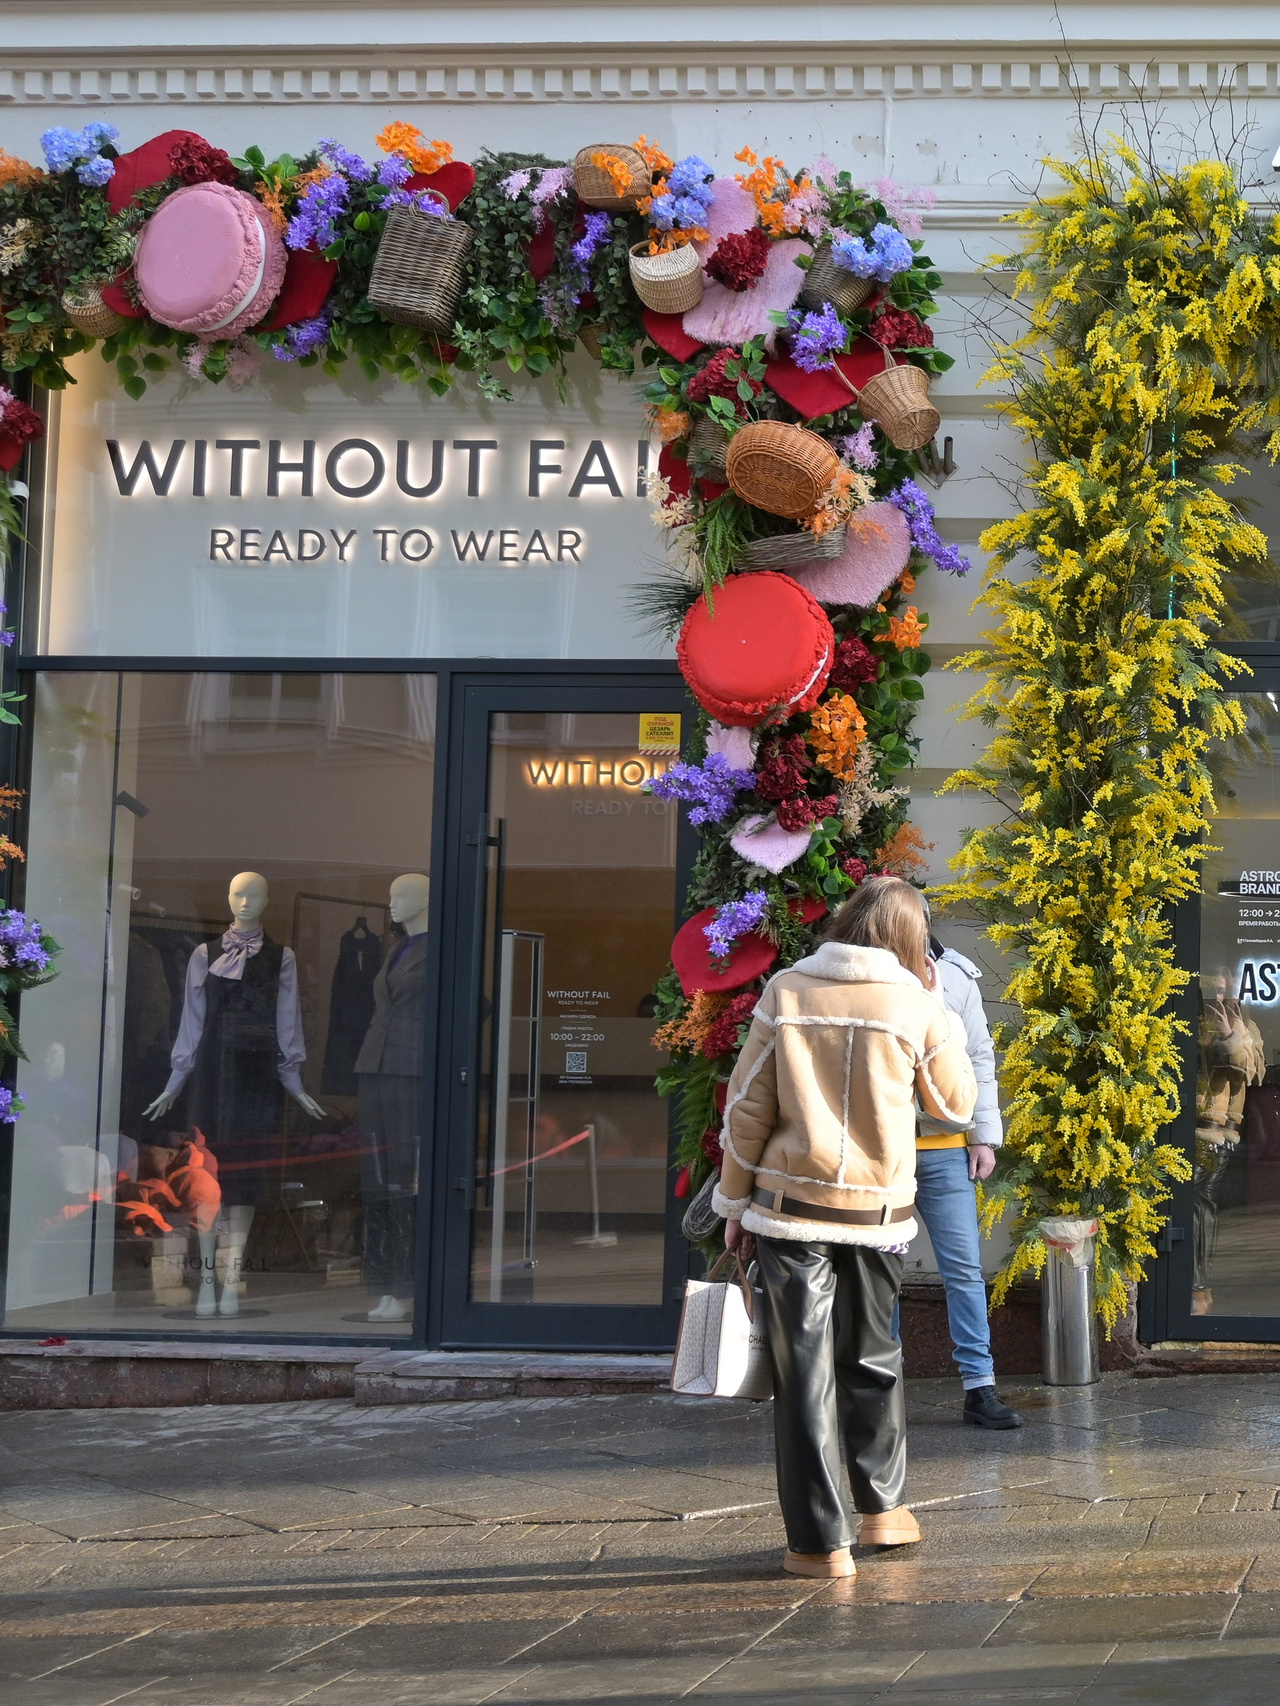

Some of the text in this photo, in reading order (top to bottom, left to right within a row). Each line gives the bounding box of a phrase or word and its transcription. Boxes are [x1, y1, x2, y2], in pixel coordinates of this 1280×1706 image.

[105, 439, 649, 498] WITHOUT FAI
[209, 528, 583, 562] READY TO WEAR
[527, 760, 670, 786] WITHOU
[572, 801, 668, 815] READY TO
[1239, 909, 1264, 918] 12:00
[547, 990, 611, 999] WITHOUT FAIL
[550, 1033, 573, 1041] 10:00
